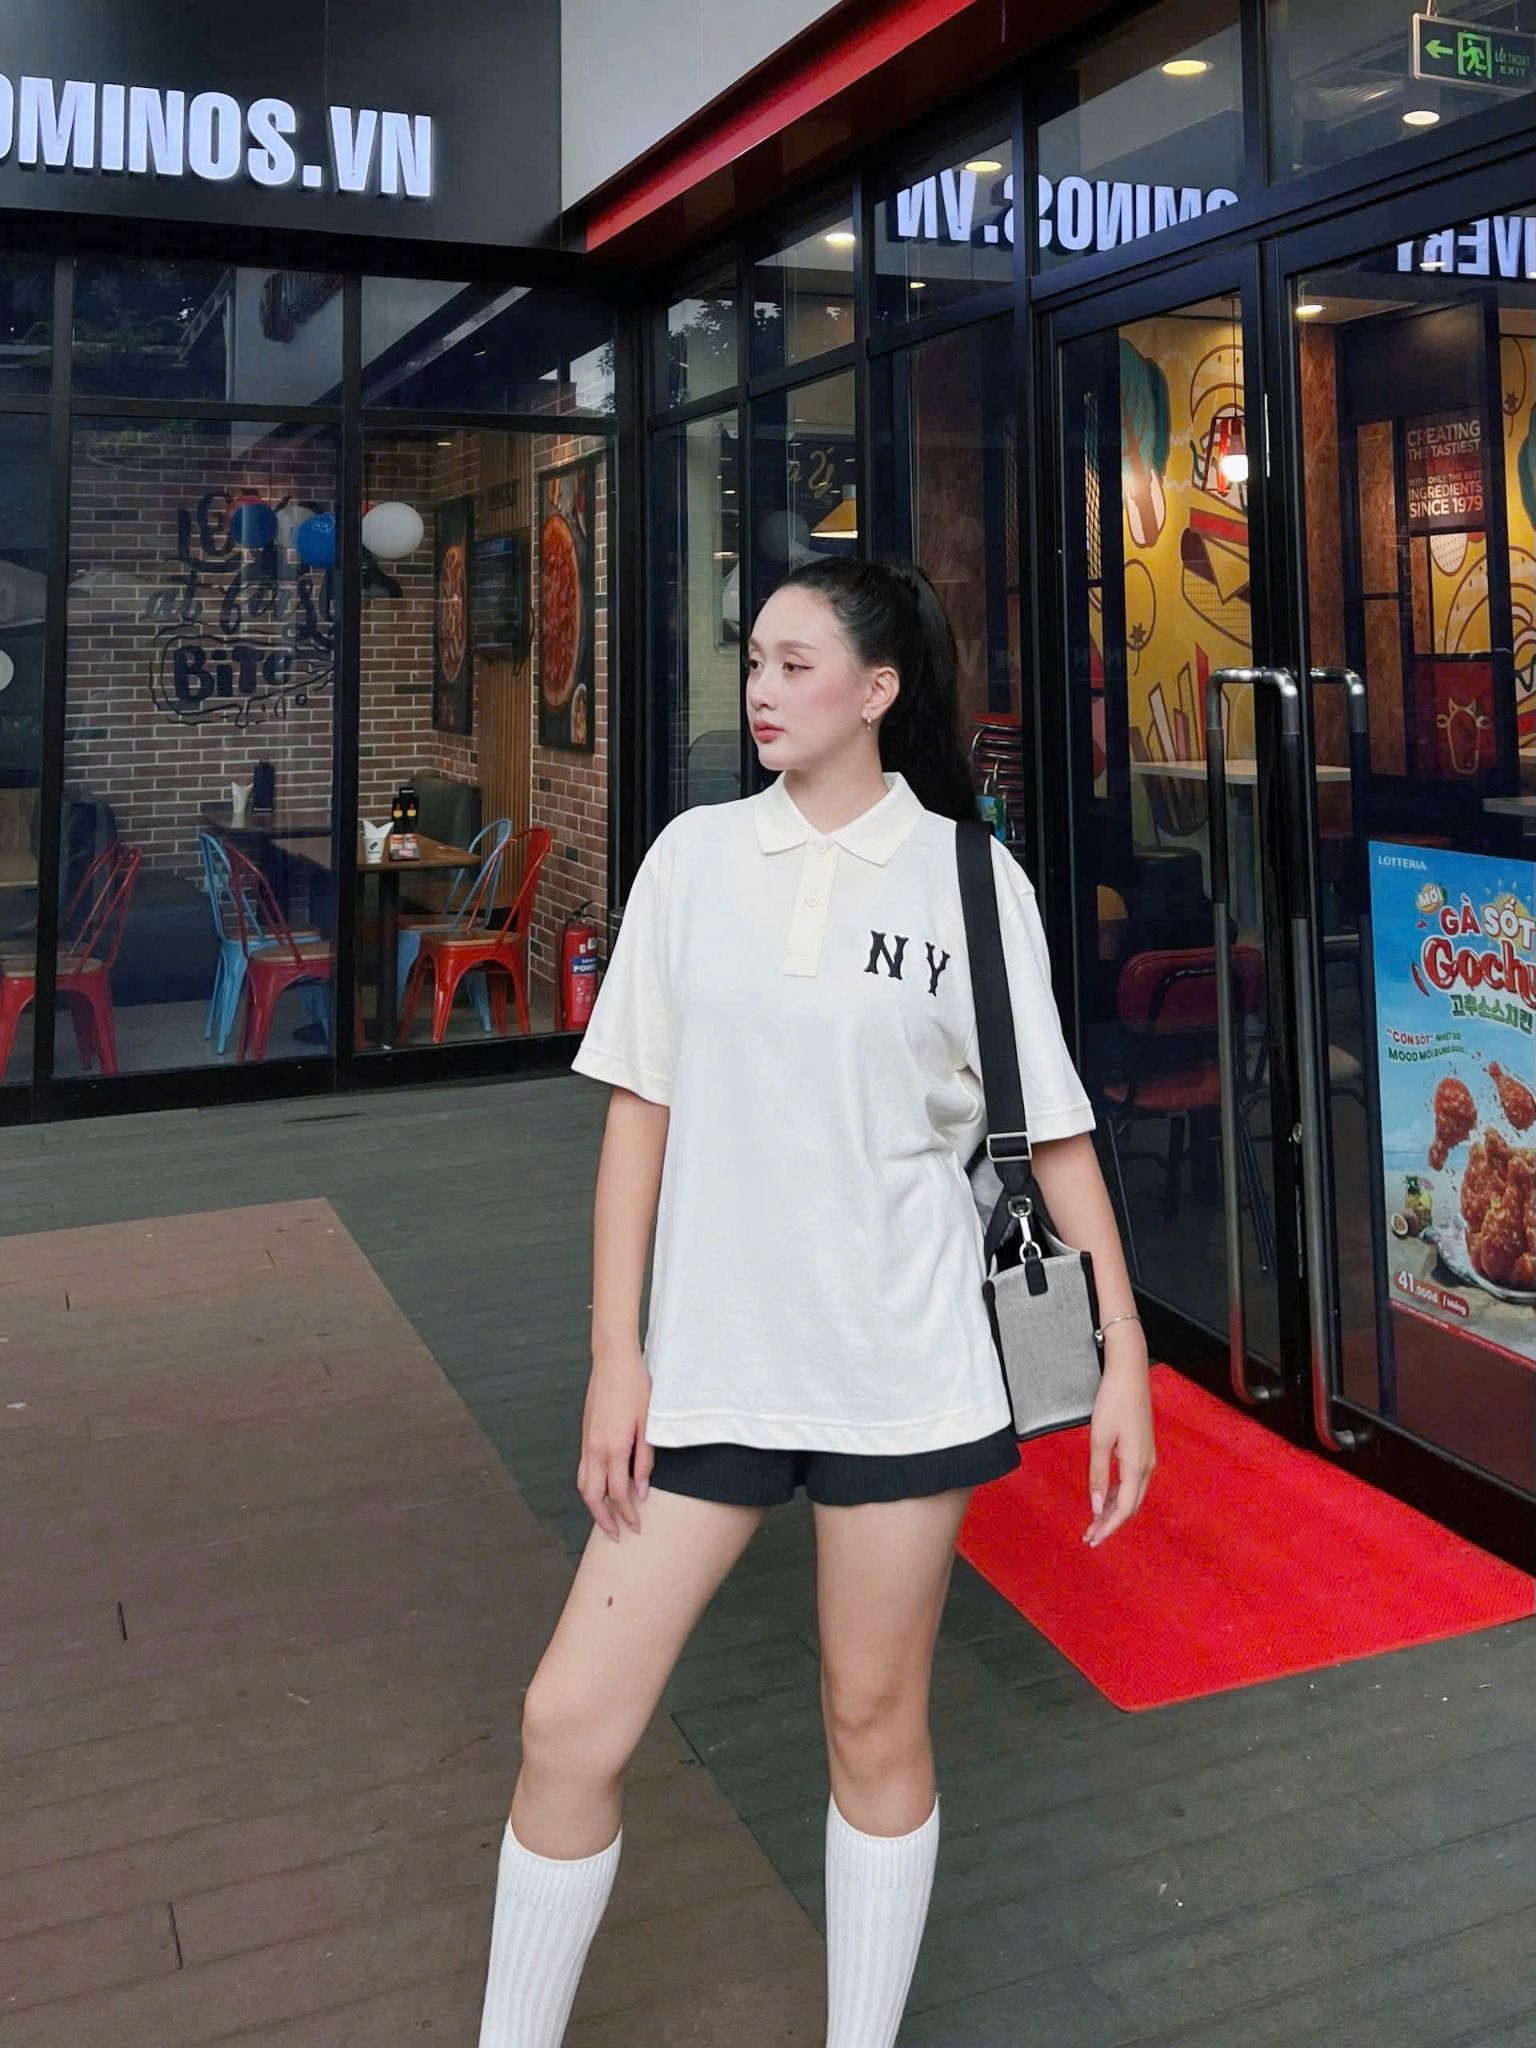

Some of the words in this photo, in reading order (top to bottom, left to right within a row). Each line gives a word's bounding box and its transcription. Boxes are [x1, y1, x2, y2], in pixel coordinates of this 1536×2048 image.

[1500, 65, 1526, 78] EXIT
[0, 74, 432, 197] MINOS.VN
[1407, 420, 1481, 447] CREATING
[1430, 439, 1481, 458] TASTIEST
[1428, 474, 1446, 485] ONLY
[1408, 481, 1483, 500] INGREDIENTS
[1409, 499, 1450, 518] SINCE
[1452, 495, 1484, 513] 1979
[1378, 855, 1428, 871] LOTTERIA
[1440, 893, 1481, 937] GÀ
[1483, 897, 1536, 949] SỐT
[1388, 1047, 1418, 1062] MOOD
